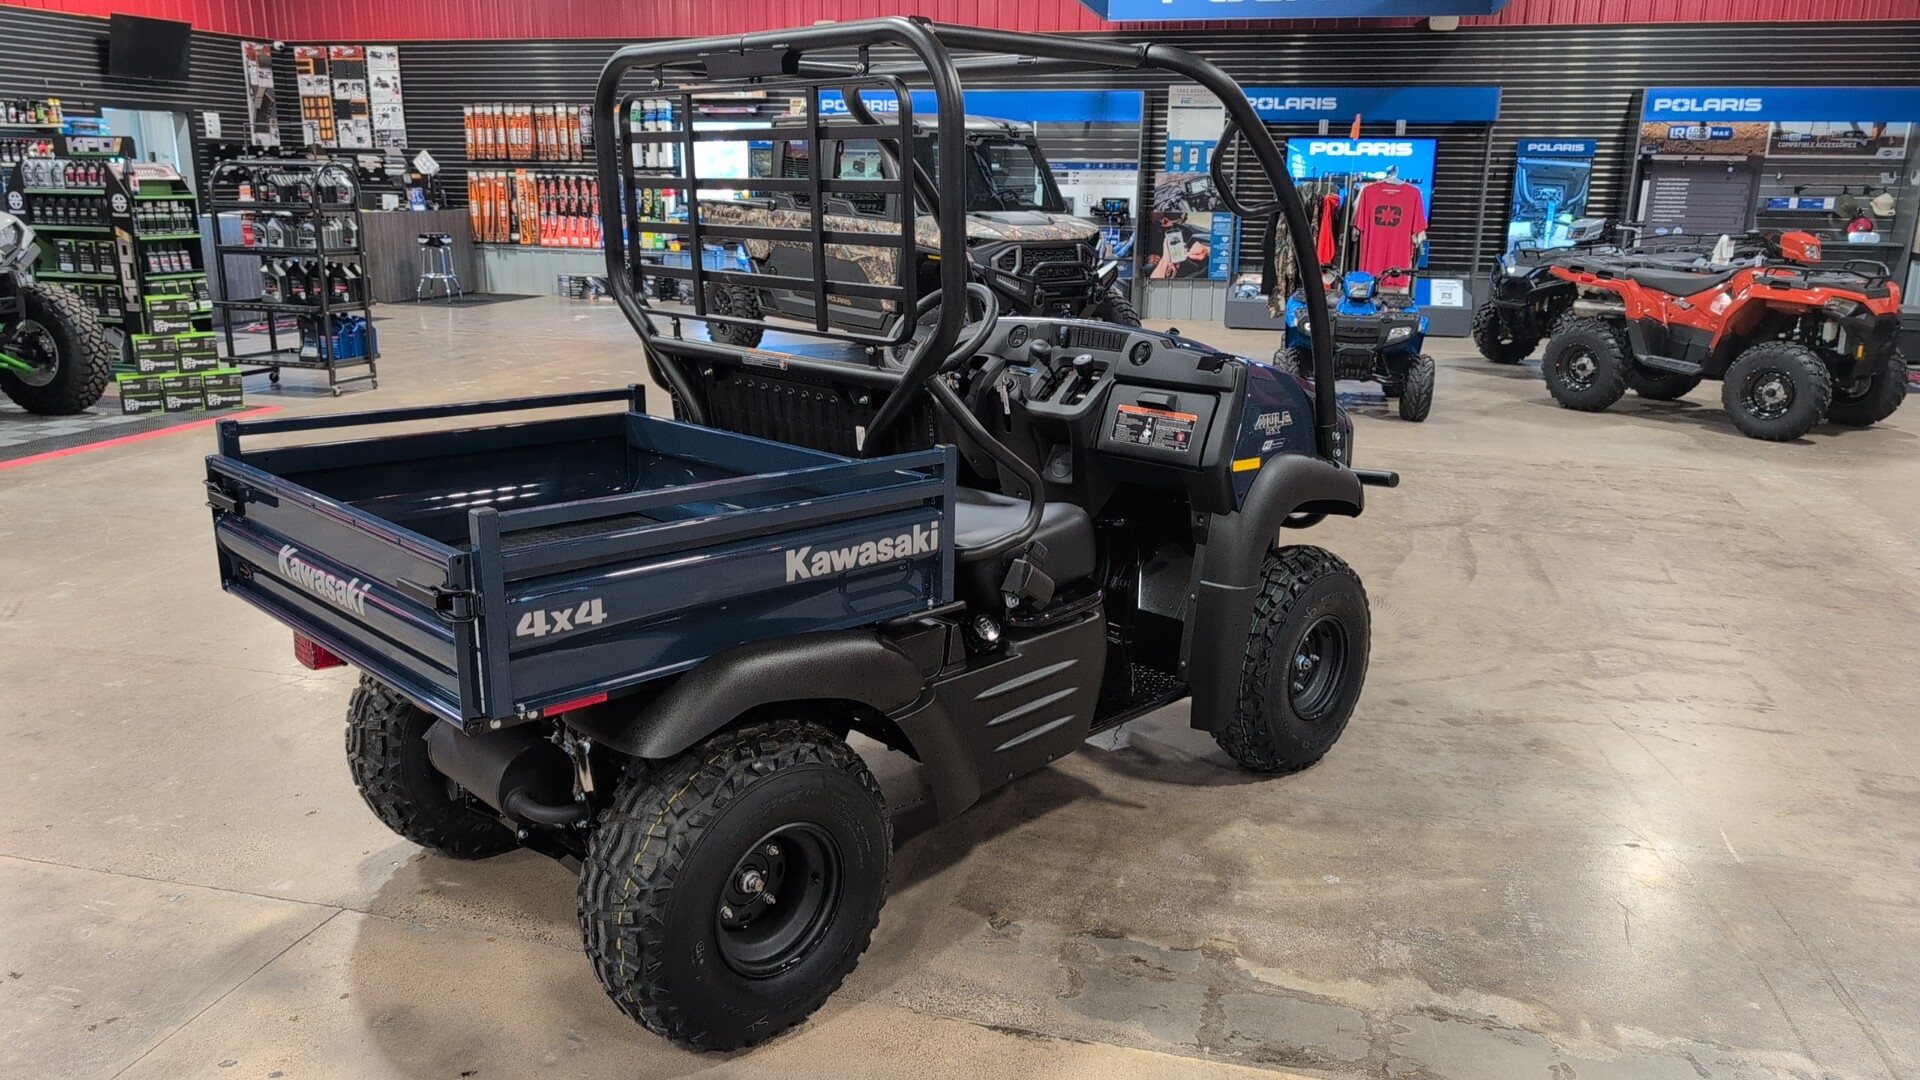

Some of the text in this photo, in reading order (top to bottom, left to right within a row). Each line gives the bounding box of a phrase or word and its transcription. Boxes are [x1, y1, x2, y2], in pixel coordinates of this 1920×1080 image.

[1247, 97, 1337, 110] POLARIS
[1653, 98, 1763, 112] POLARIS
[1309, 142, 1413, 156] POLARIS
[1527, 143, 1585, 152] POLARIS
[711, 209, 741, 219] RANGER
[1254, 411, 1293, 430] MULE
[1266, 427, 1281, 436] SX
[785, 521, 938, 582] Kawasaki
[278, 544, 372, 617] Kawasaki
[516, 598, 608, 638] 4x4
